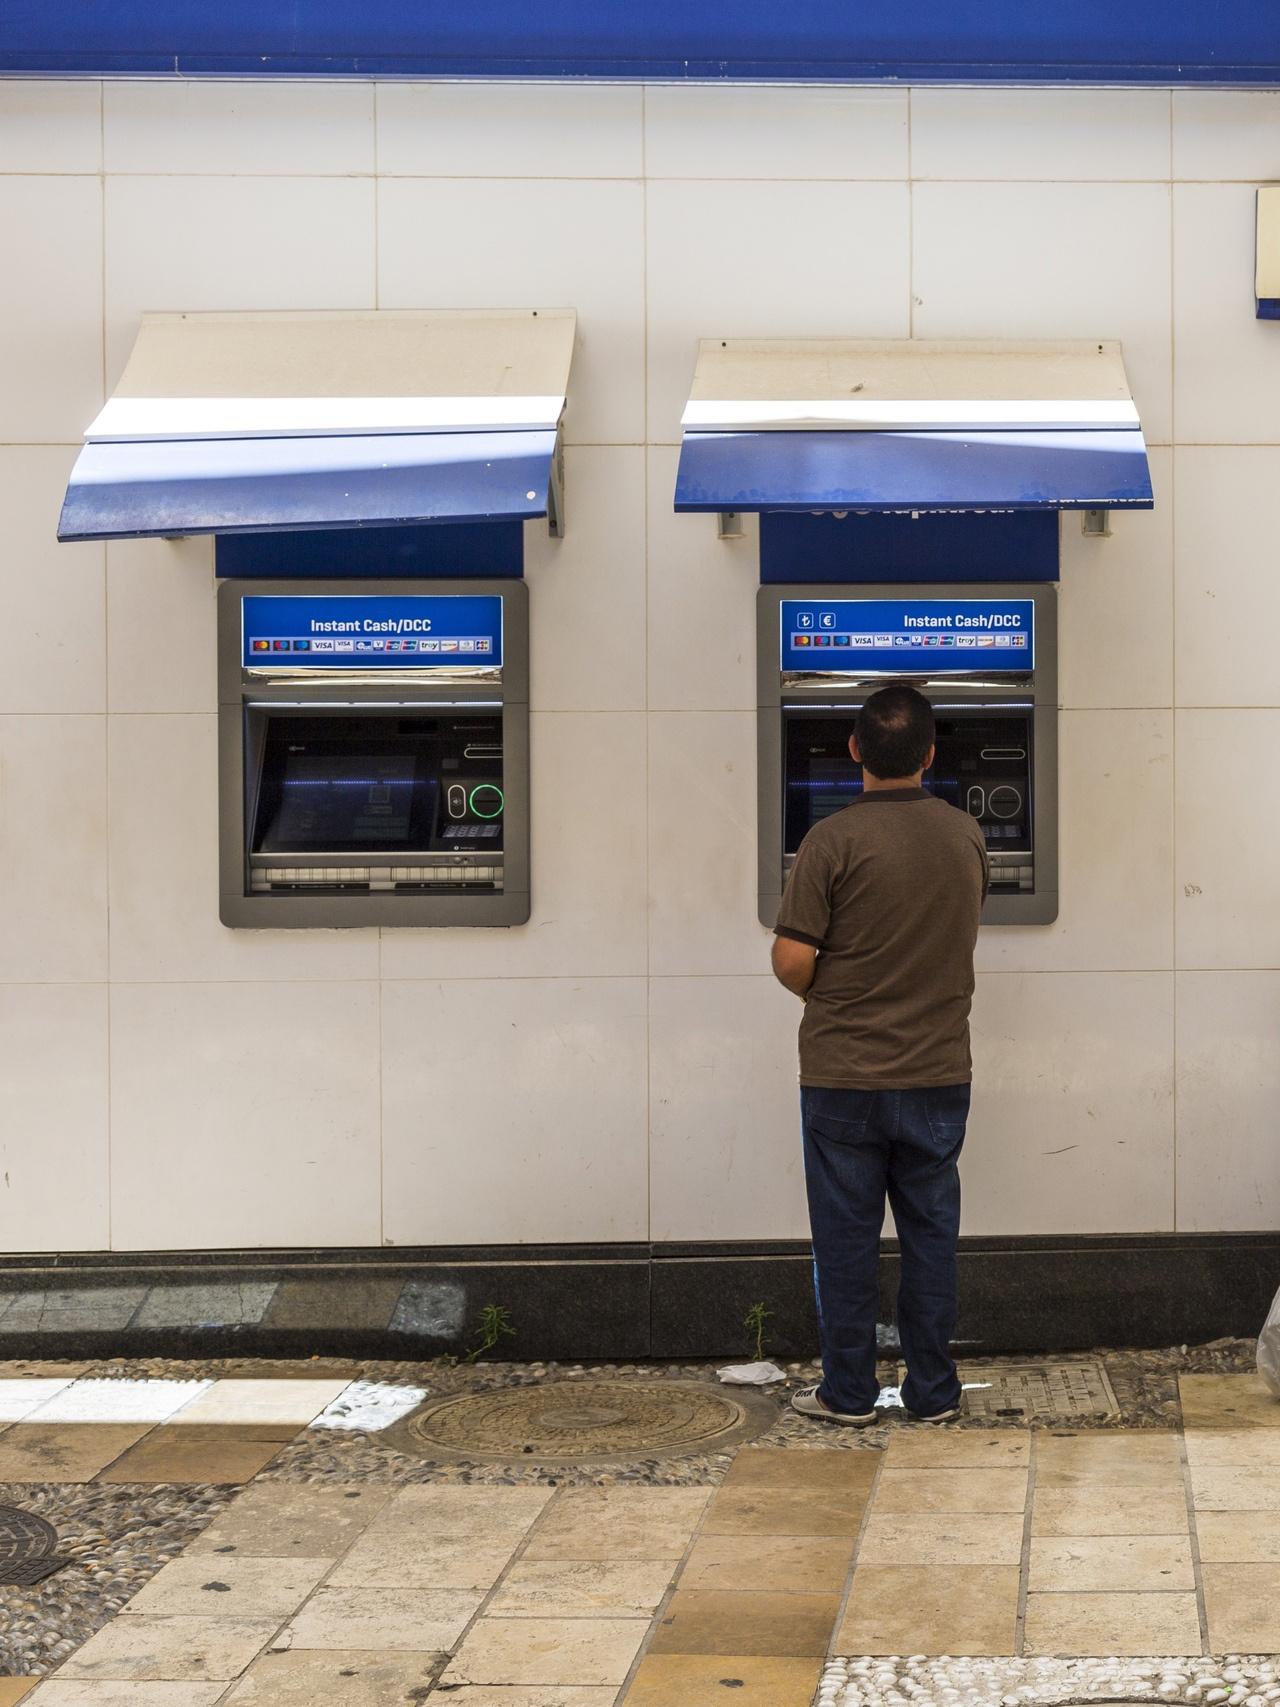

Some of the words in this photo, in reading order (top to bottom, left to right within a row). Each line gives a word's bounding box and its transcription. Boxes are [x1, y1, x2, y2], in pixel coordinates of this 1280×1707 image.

[311, 619, 361, 632] Instant
[363, 619, 431, 634] Cash/DCC
[904, 615, 952, 627] Instant
[955, 614, 1021, 629] Cash/DCC
[421, 642, 438, 650] troy
[958, 637, 975, 645] troy
